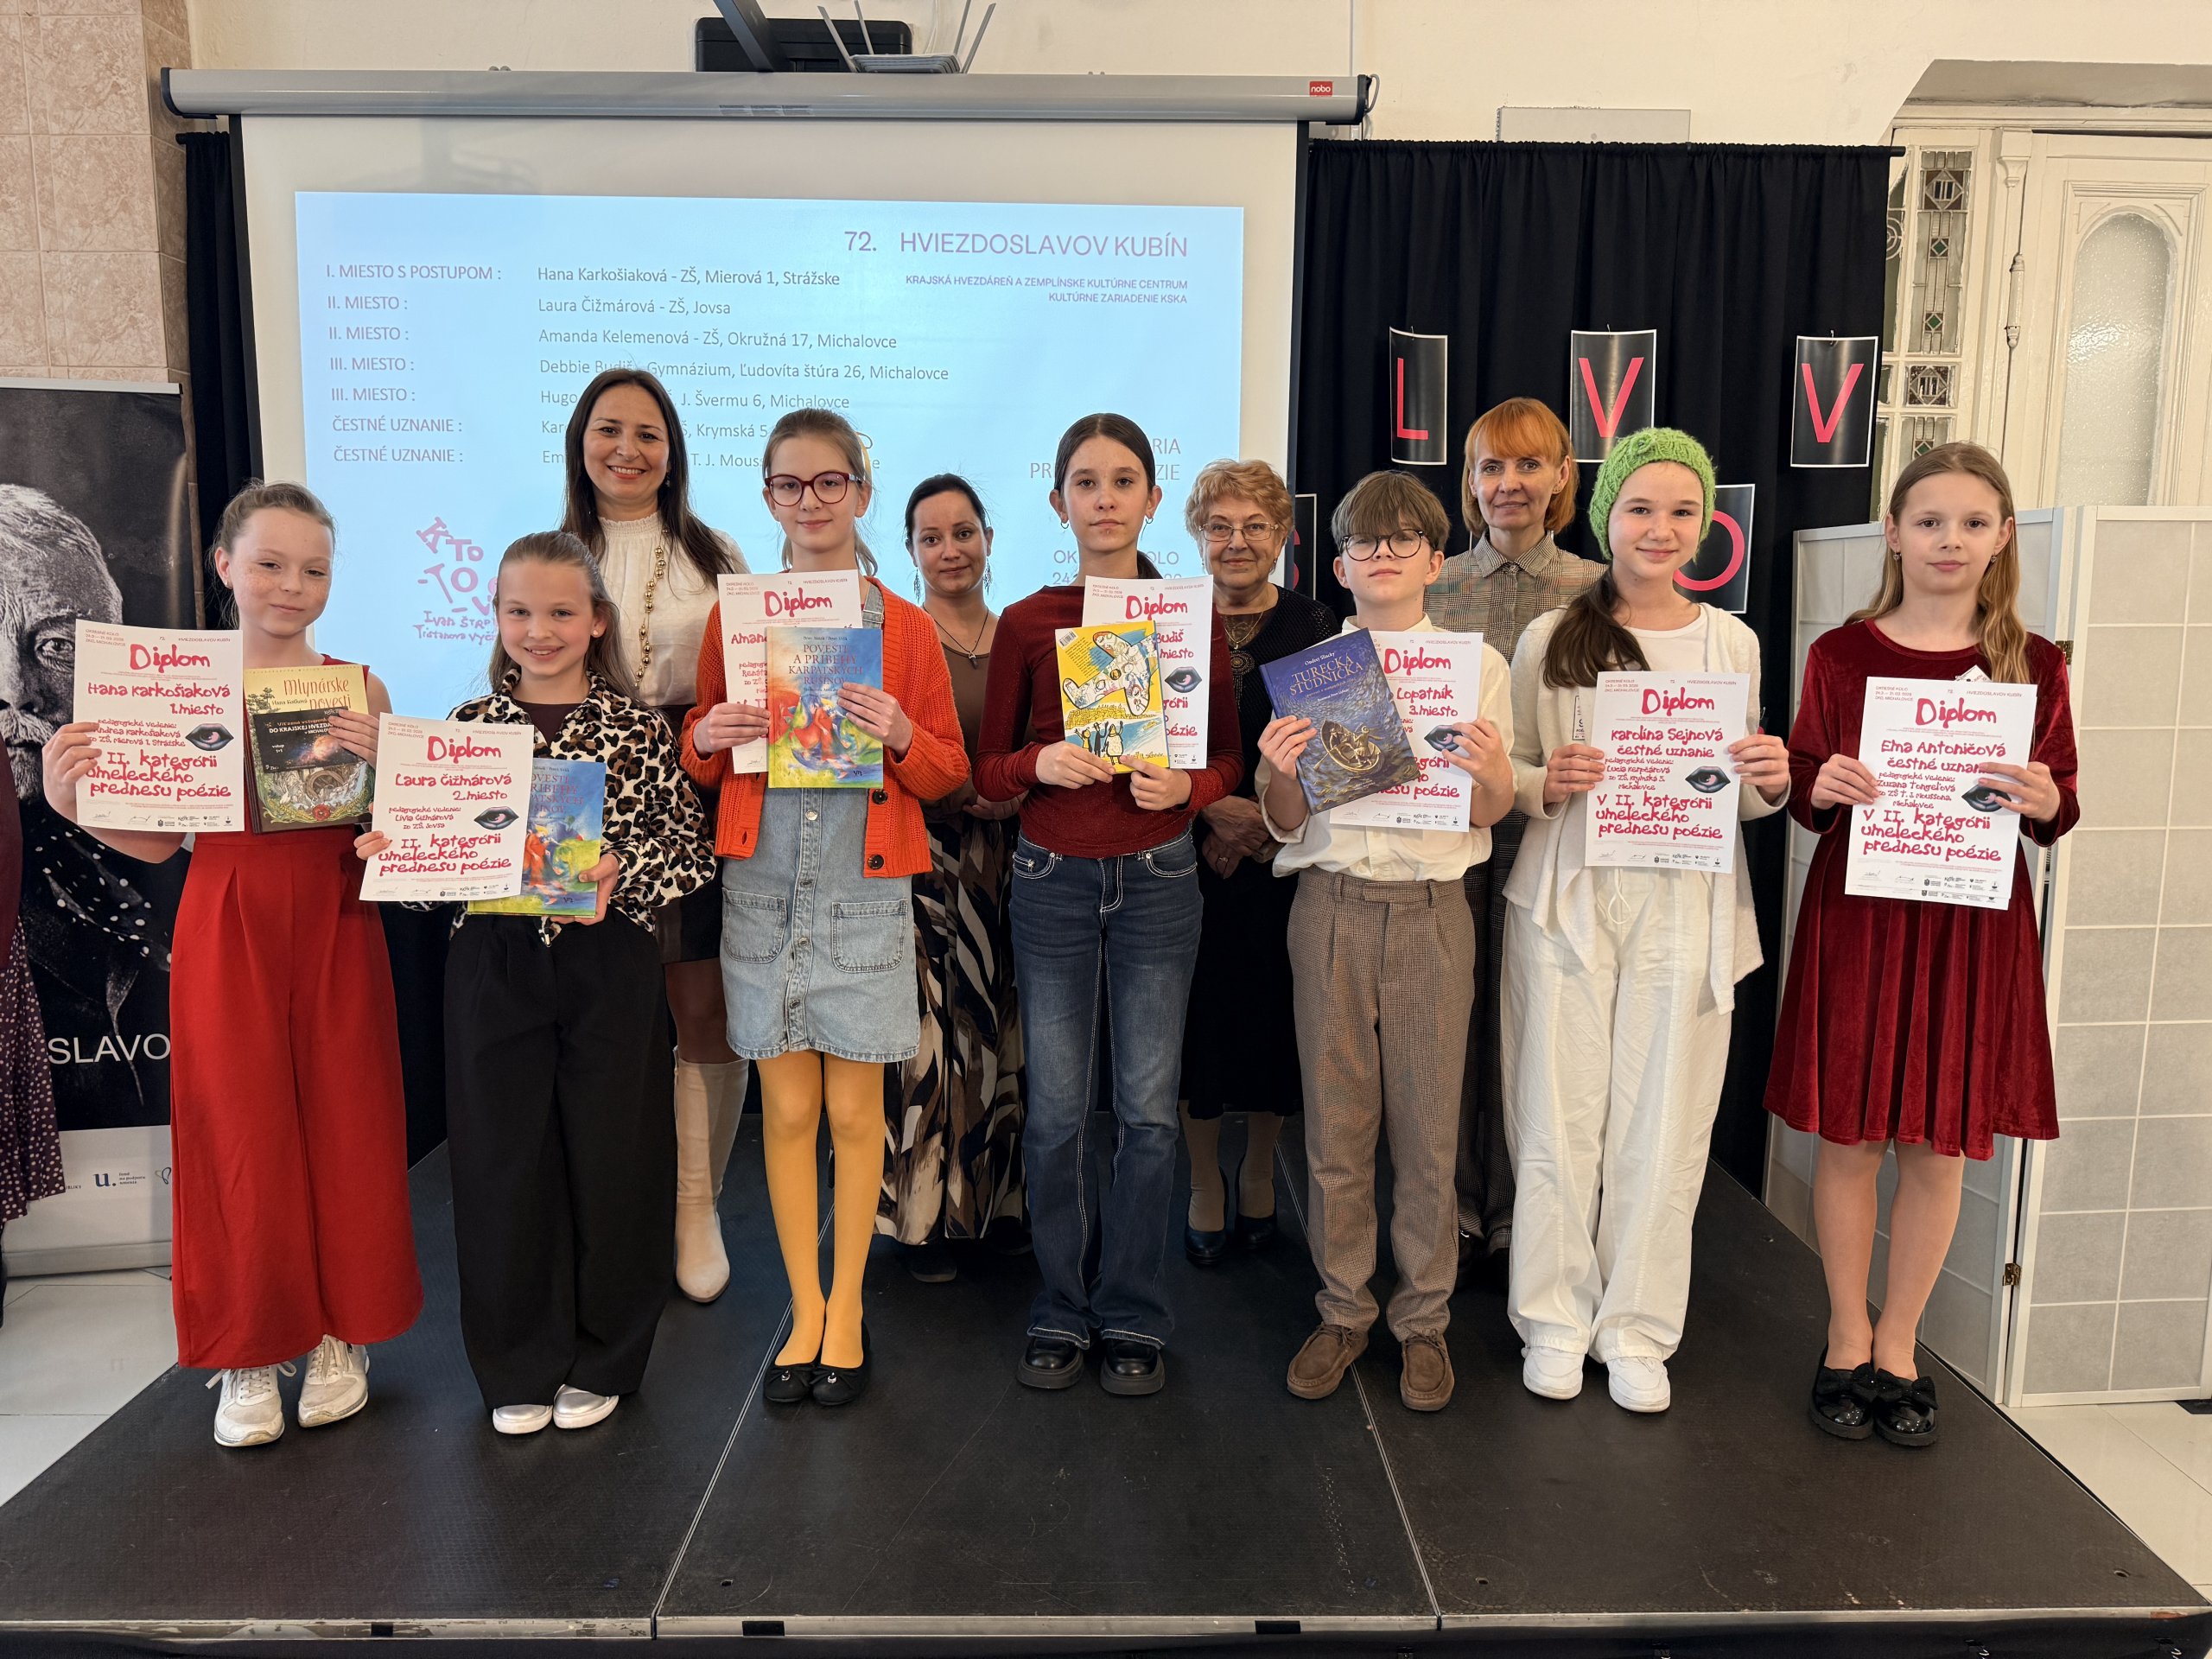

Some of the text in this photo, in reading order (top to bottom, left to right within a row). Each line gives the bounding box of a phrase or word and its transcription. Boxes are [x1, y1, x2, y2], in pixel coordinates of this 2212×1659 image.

[844, 231, 1188, 257] 72. HVIEZDOSLAVOV KUBÍN
[326, 264, 493, 280] I. MIESTO S POSTUPOM
[537, 266, 841, 286] Hana Karkošiaková ZŠ, Mierová 1, Strážske
[906, 275, 1188, 289] KRAJSKÁ HVEZDÁREŇ A ZEMPLÍNSKE KULTÚRNE CENTRUM
[327, 296, 400, 310] II. MIESTO
[538, 296, 731, 316] Laura Čižmárová ZŠ, Jovsa
[1048, 290, 1187, 303] KULTÚRNE ZARIADENIE KSKA
[329, 327, 401, 340] II. MIESTO
[538, 328, 897, 349] Amanda Kelemenová ZŠ, Okružná 17, Michalovce
[330, 357, 406, 371] III. MIESTO
[540, 359, 949, 380] Debbie Gymnázium, Ľudovíta štúra 26, Michalovce
[331, 388, 408, 402] III. MIESTO
[541, 391, 578, 407] Hugo
[681, 393, 690, 406] J.
[695, 390, 747, 407] Švermu
[753, 394, 766, 410] 6,
[770, 394, 849, 409] Michalovce
[1396, 357, 1428, 441] L
[1578, 357, 1644, 437] V
[1802, 363, 1864, 443] V
[332, 415, 454, 432] ČESTNÉ UZNANIE
[696, 423, 754, 440] Krymská
[334, 445, 455, 462] ČESTNÉ UZNANIE
[691, 454, 715, 467] T. J.
[764, 588, 833, 618] Diplom
[1125, 594, 1188, 620] Diplom
[423, 610, 455, 626] Ivan
[130, 644, 211, 673] Diplom
[793, 654, 801, 664] A
[1292, 652, 1354, 683] TURECKÁ
[1383, 646, 1452, 676] Diplom
[283, 677, 349, 696] Mlynárske
[1289, 662, 1363, 696] STUDNIČKA
[87, 682, 231, 697] Hana Karkošiaková
[1396, 684, 1454, 703] Lopatník
[1641, 687, 1715, 716] Diplom
[1915, 697, 1997, 728] Diplom
[1611, 725, 1724, 746] Karolína Sejnová
[427, 736, 502, 764] Diplom
[1617, 744, 1715, 758] čestné uznanie
[1881, 739, 2006, 758] Ema Antoničová
[140, 749, 218, 771] kategórii
[1887, 757, 1937, 771] čestné
[86, 764, 194, 783] umeleckého
[395, 773, 512, 787] Laura Čižmárová
[90, 782, 232, 802] prednesu poézie
[1414, 783, 1460, 800] poézie
[1615, 794, 1635, 806] II.
[1643, 791, 1713, 810] kategórii
[1595, 804, 1689, 823] umeleckého
[1884, 810, 1904, 823] II.
[1914, 808, 1991, 830] kategórii
[1598, 822, 1723, 841] prednesu poézie
[1860, 822, 1964, 844] umeleckého
[430, 834, 501, 849] kategórii
[1863, 839, 2002, 862] prednesu poézie
[378, 847, 479, 861] umeleckého
[379, 858, 512, 876] prednesu poézie
[48, 1033, 172, 1065] SLAVO
